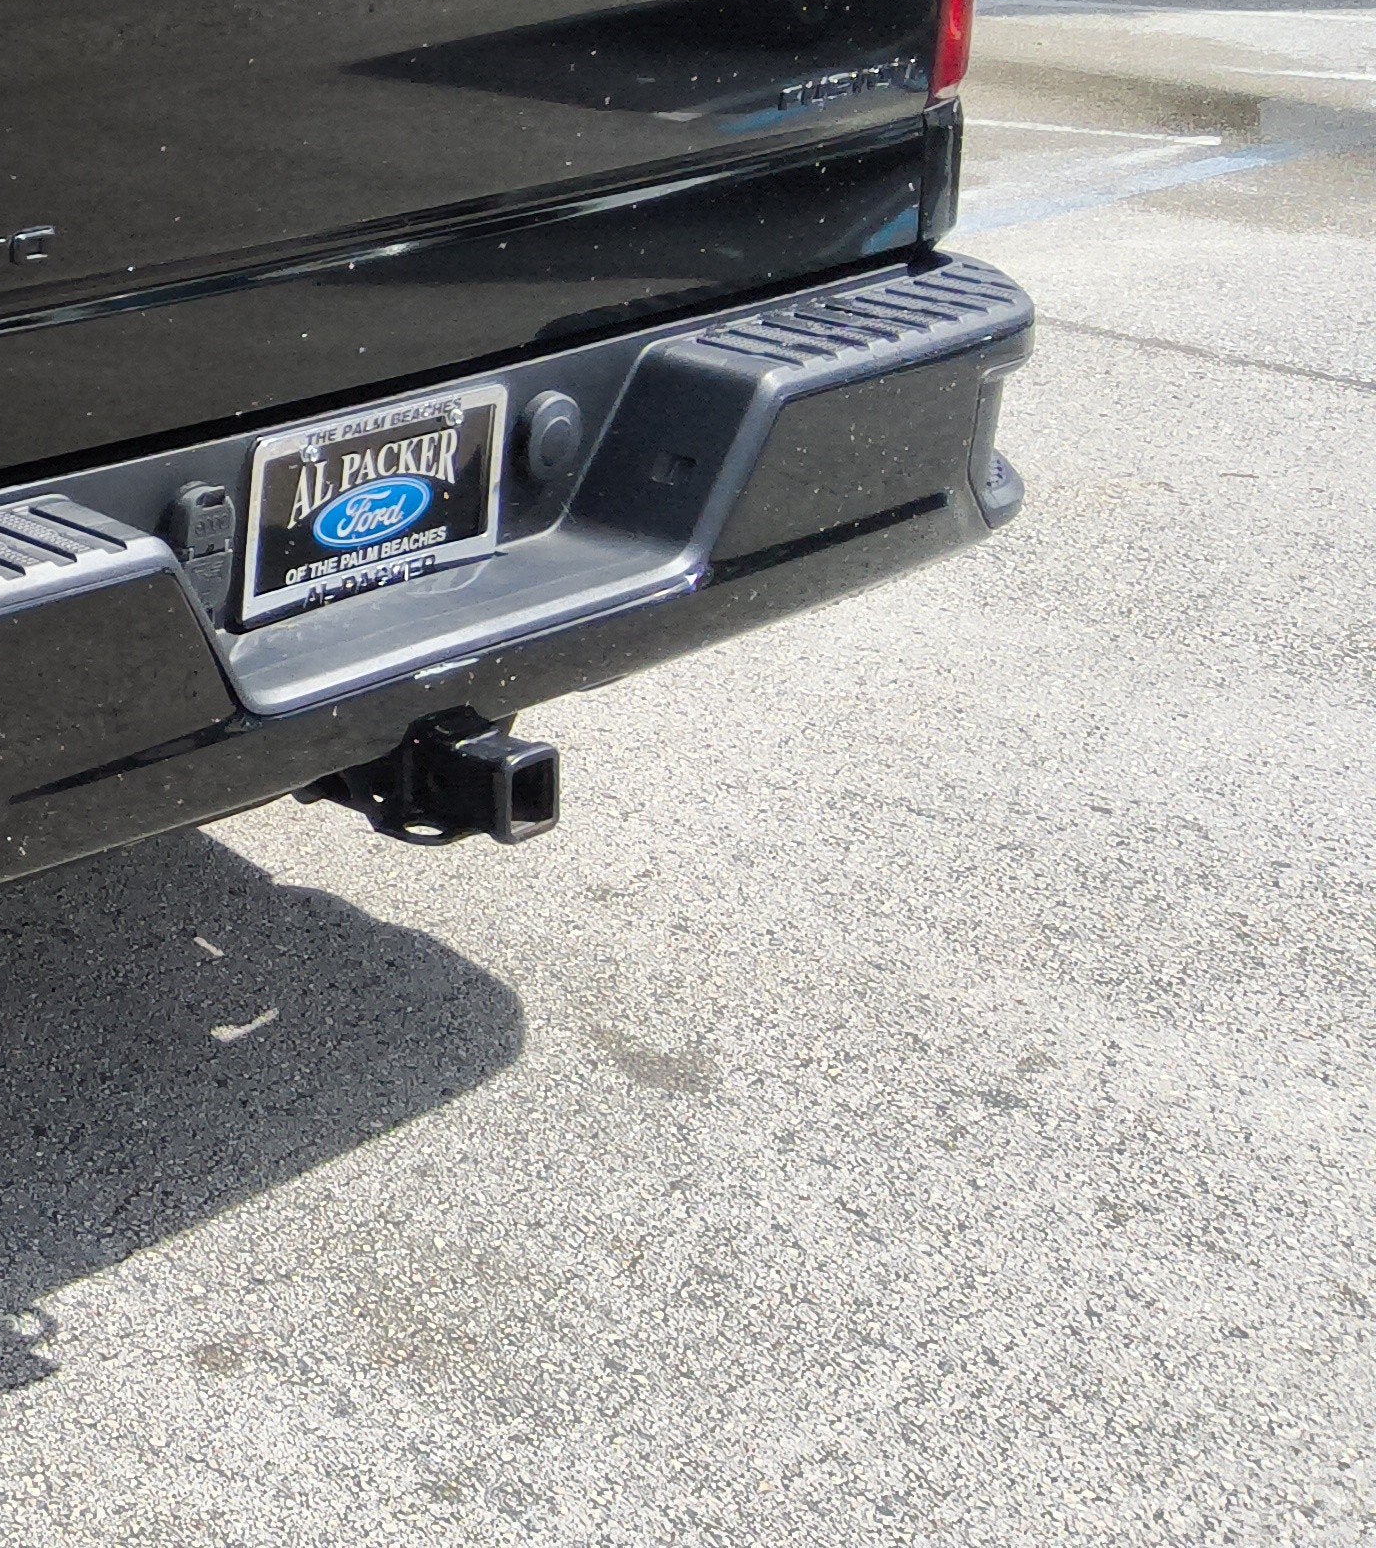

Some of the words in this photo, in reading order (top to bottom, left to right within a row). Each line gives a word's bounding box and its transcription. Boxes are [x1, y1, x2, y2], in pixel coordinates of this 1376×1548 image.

[342, 415, 386, 441] PALM
[390, 397, 462, 426] BEACHES
[286, 460, 333, 530] AL
[339, 428, 459, 493] PACKER
[336, 487, 407, 539] Ford
[285, 563, 311, 585] OF
[310, 556, 339, 579] THE
[340, 545, 380, 569] PALM
[381, 525, 446, 558] BEACHES
